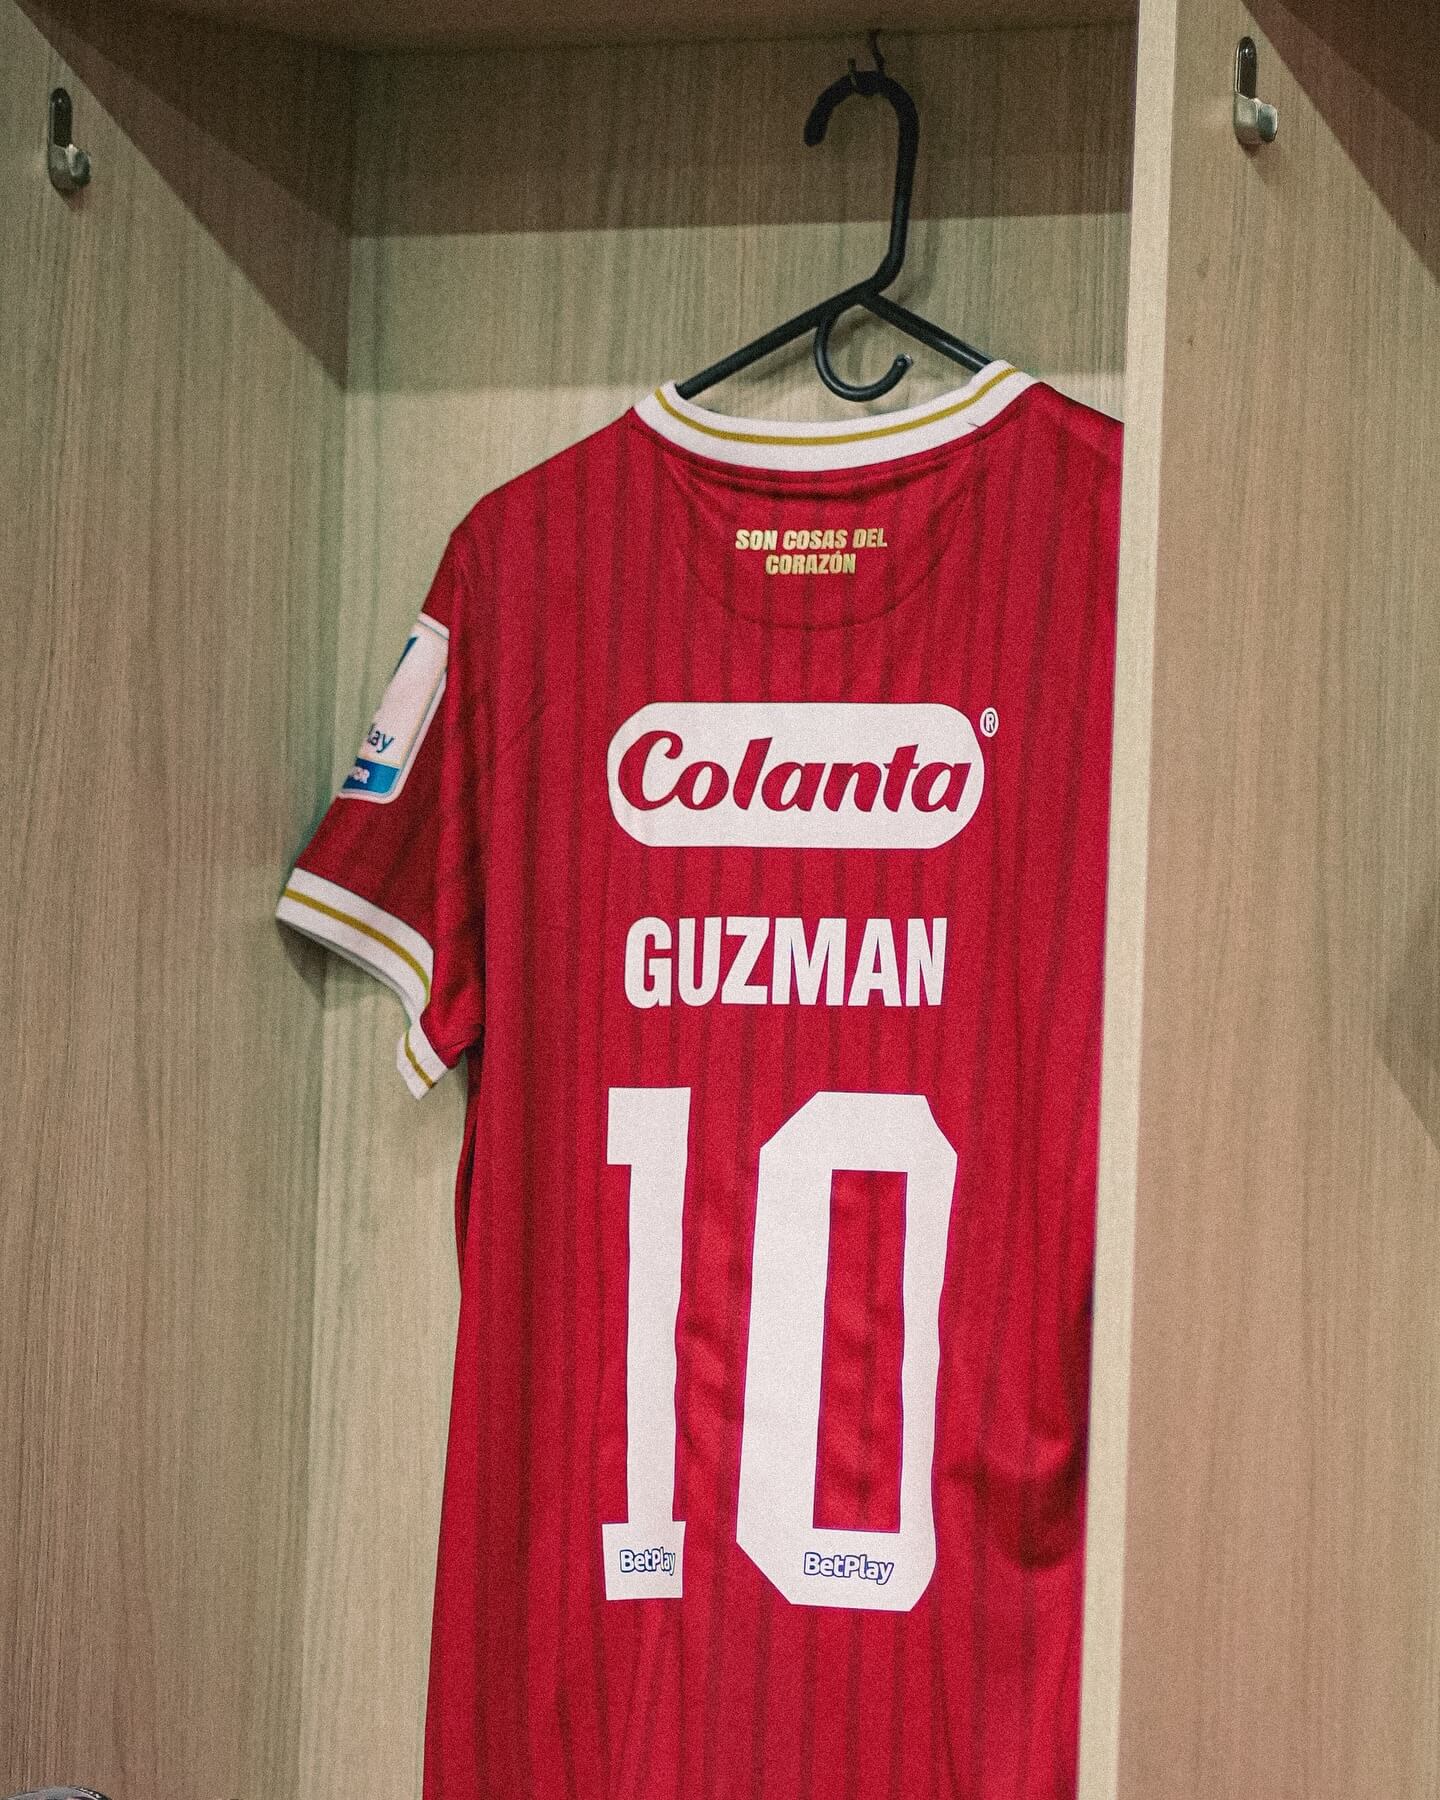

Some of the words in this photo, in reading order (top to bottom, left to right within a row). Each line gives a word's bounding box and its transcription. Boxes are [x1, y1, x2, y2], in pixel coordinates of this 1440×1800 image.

[735, 529, 777, 550] SON
[783, 529, 848, 550] COSAS
[852, 528, 887, 549] DEL
[766, 550, 856, 575] CORAZÓN
[618, 730, 972, 812] Colanta
[624, 916, 948, 1009] GUZMAN
[602, 1087, 958, 1612] 10
[619, 1546, 676, 1576] BetPlay
[803, 1552, 894, 1585] BetPlay
